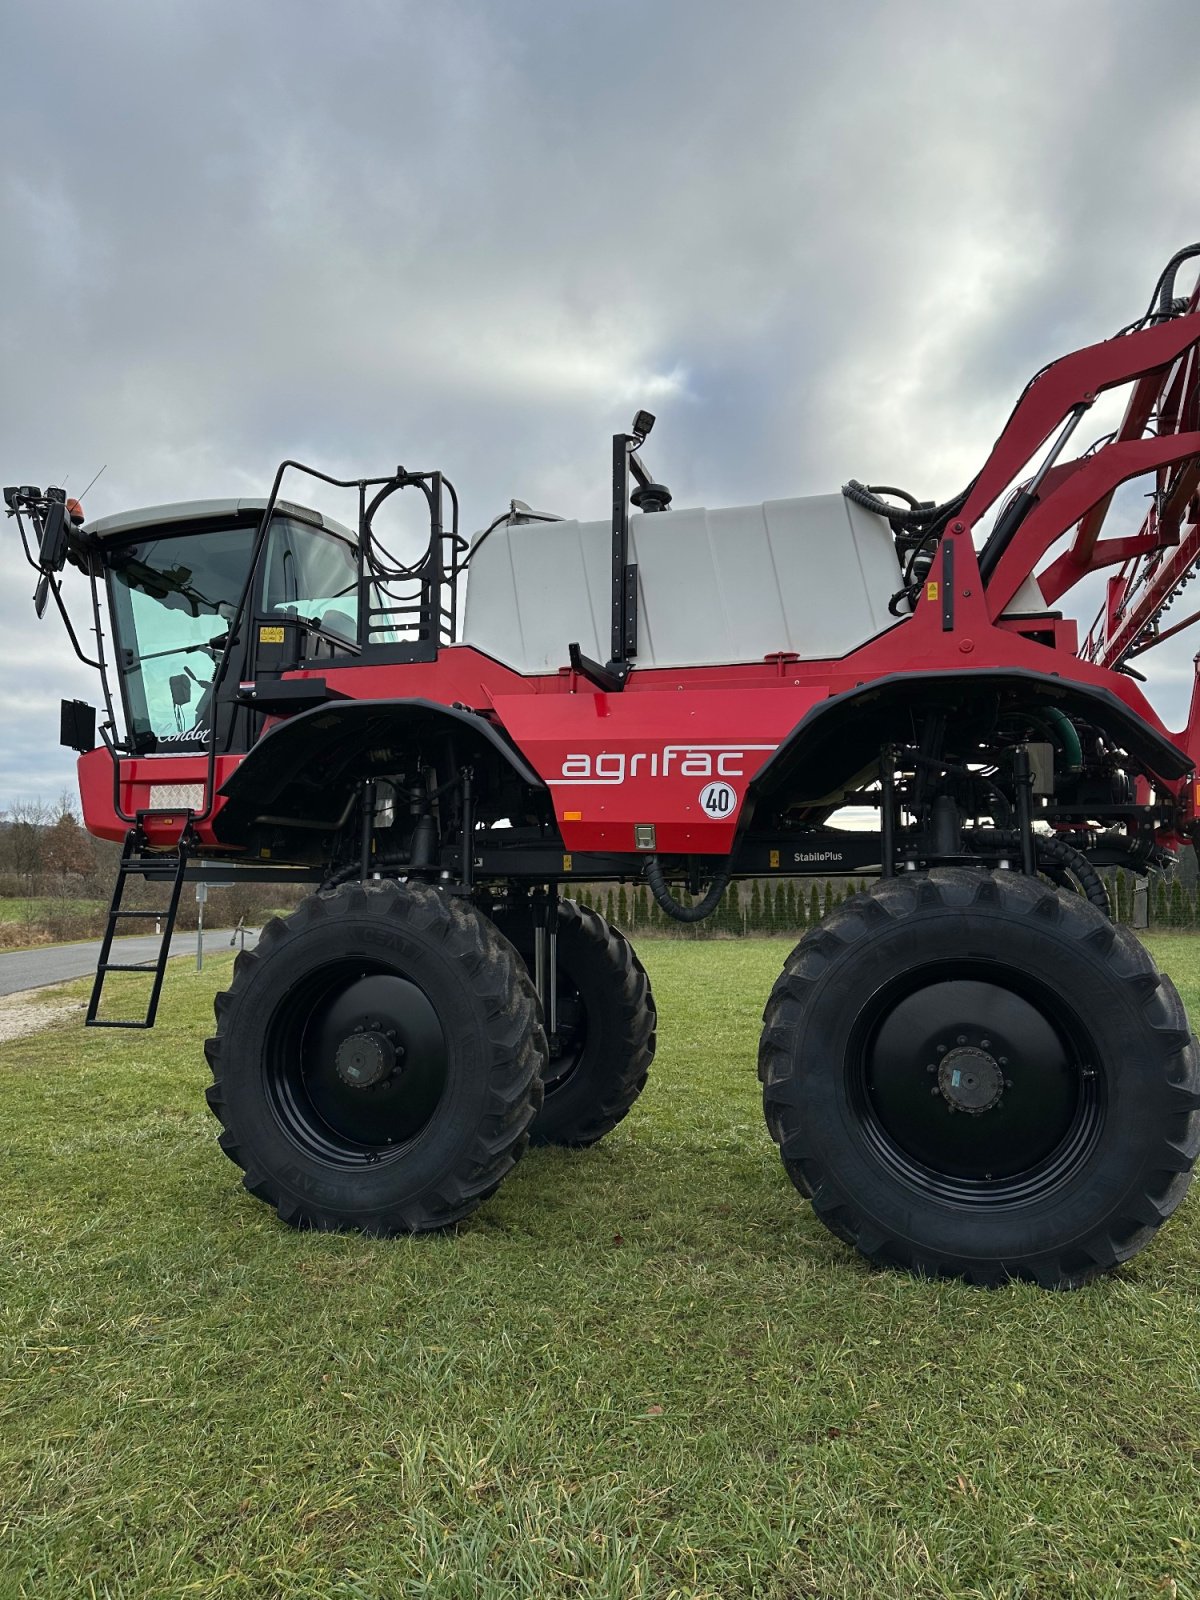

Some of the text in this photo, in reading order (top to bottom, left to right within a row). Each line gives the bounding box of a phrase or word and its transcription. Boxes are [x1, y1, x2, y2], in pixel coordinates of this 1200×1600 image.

[157, 719, 212, 743] Condor
[560, 744, 745, 785] agrifac
[705, 788, 730, 812] 40
[793, 851, 843, 862] StabiloPlus
